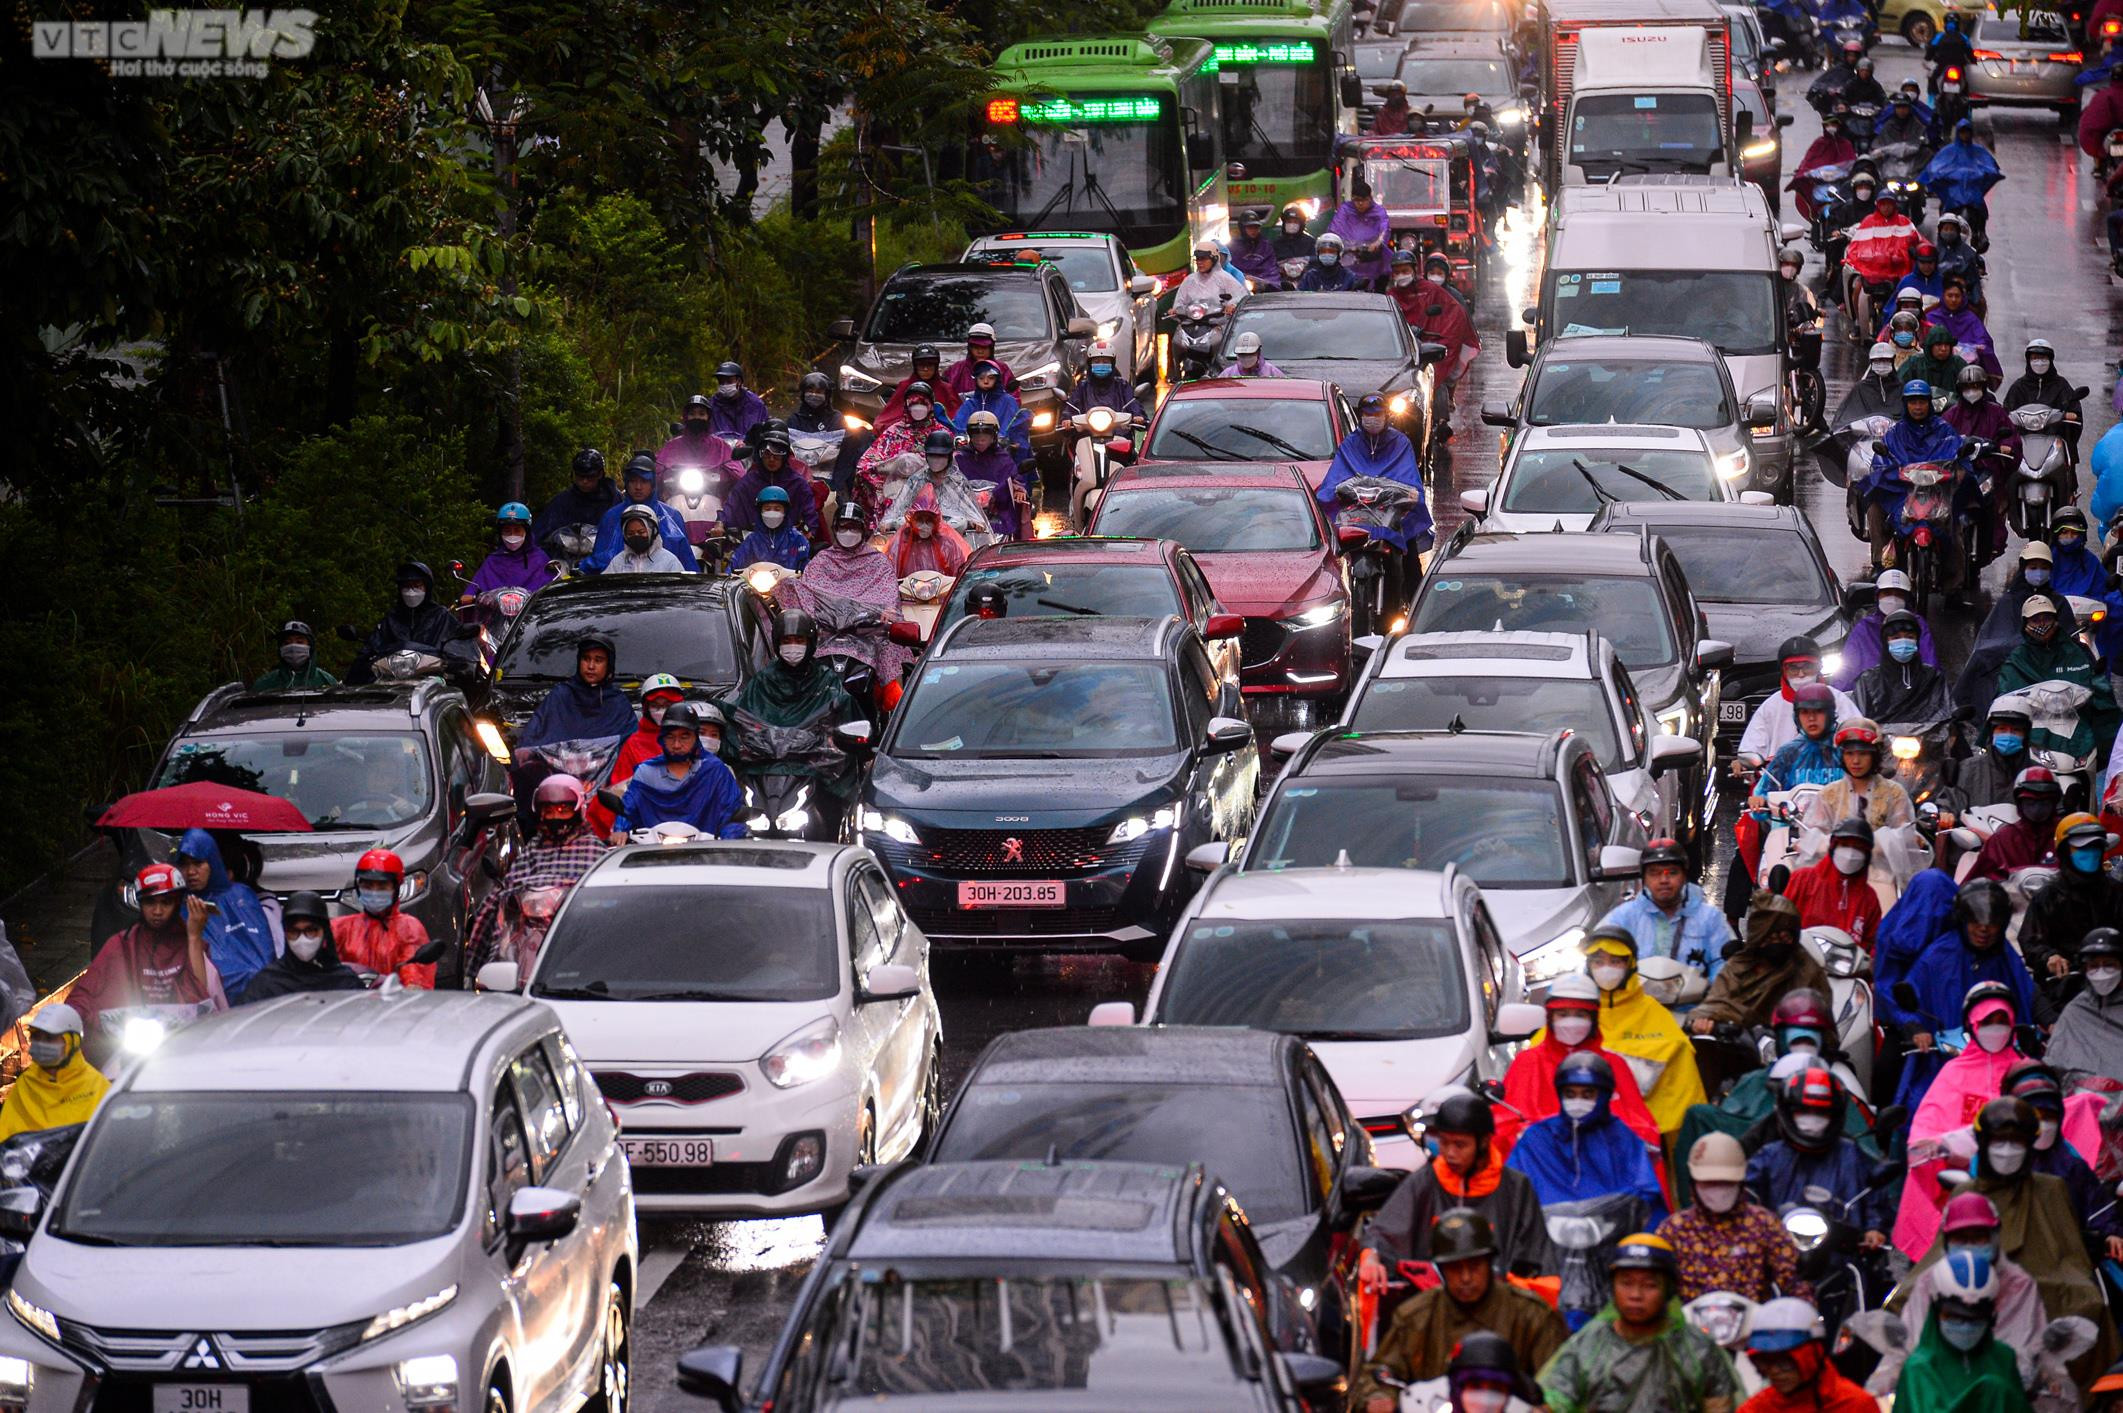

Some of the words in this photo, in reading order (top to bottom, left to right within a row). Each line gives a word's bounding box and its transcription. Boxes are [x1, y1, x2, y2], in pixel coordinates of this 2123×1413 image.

[1720, 704, 1744, 720] .98
[967, 886, 1056, 900] 30H-203.85
[648, 1084, 668, 1093] KIA
[618, 1143, 708, 1163] F-550.98
[181, 1389, 222, 1409] 30H
